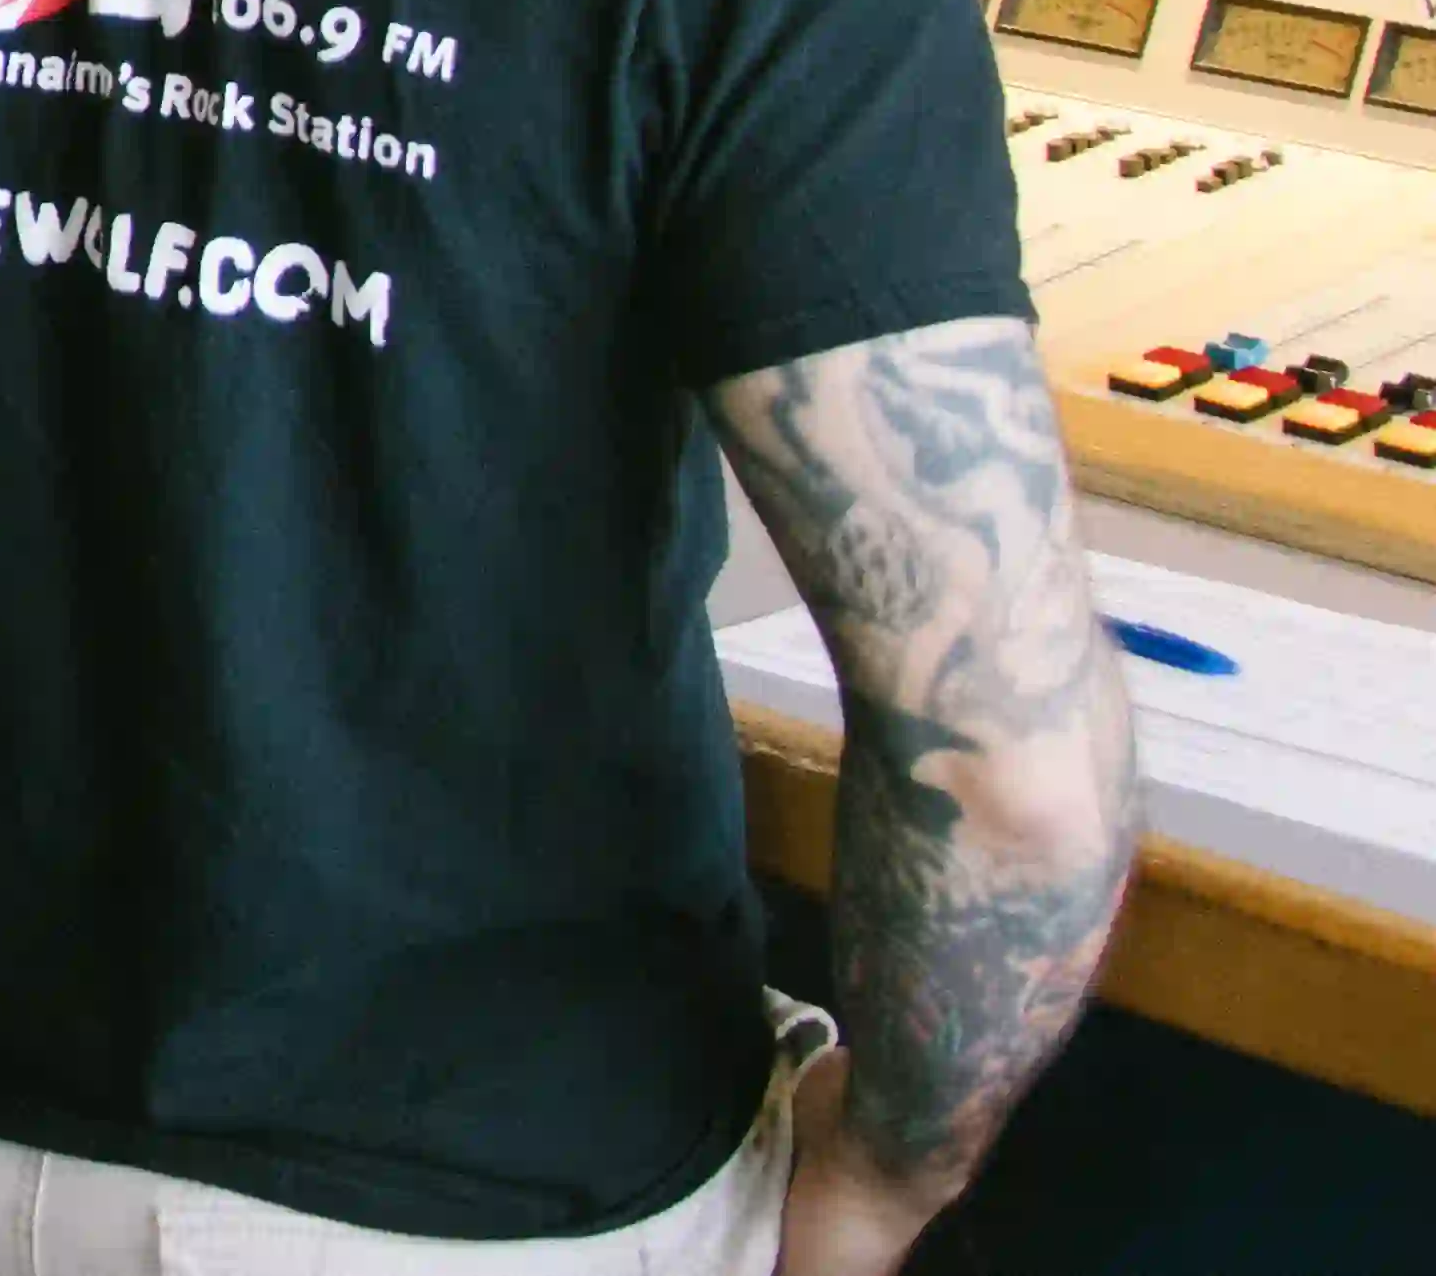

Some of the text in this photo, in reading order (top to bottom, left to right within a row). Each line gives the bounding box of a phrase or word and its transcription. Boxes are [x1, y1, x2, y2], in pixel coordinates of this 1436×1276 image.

[383, 22, 458, 82] FM
[161, 72, 255, 132] Rock
[268, 91, 437, 180] Station
